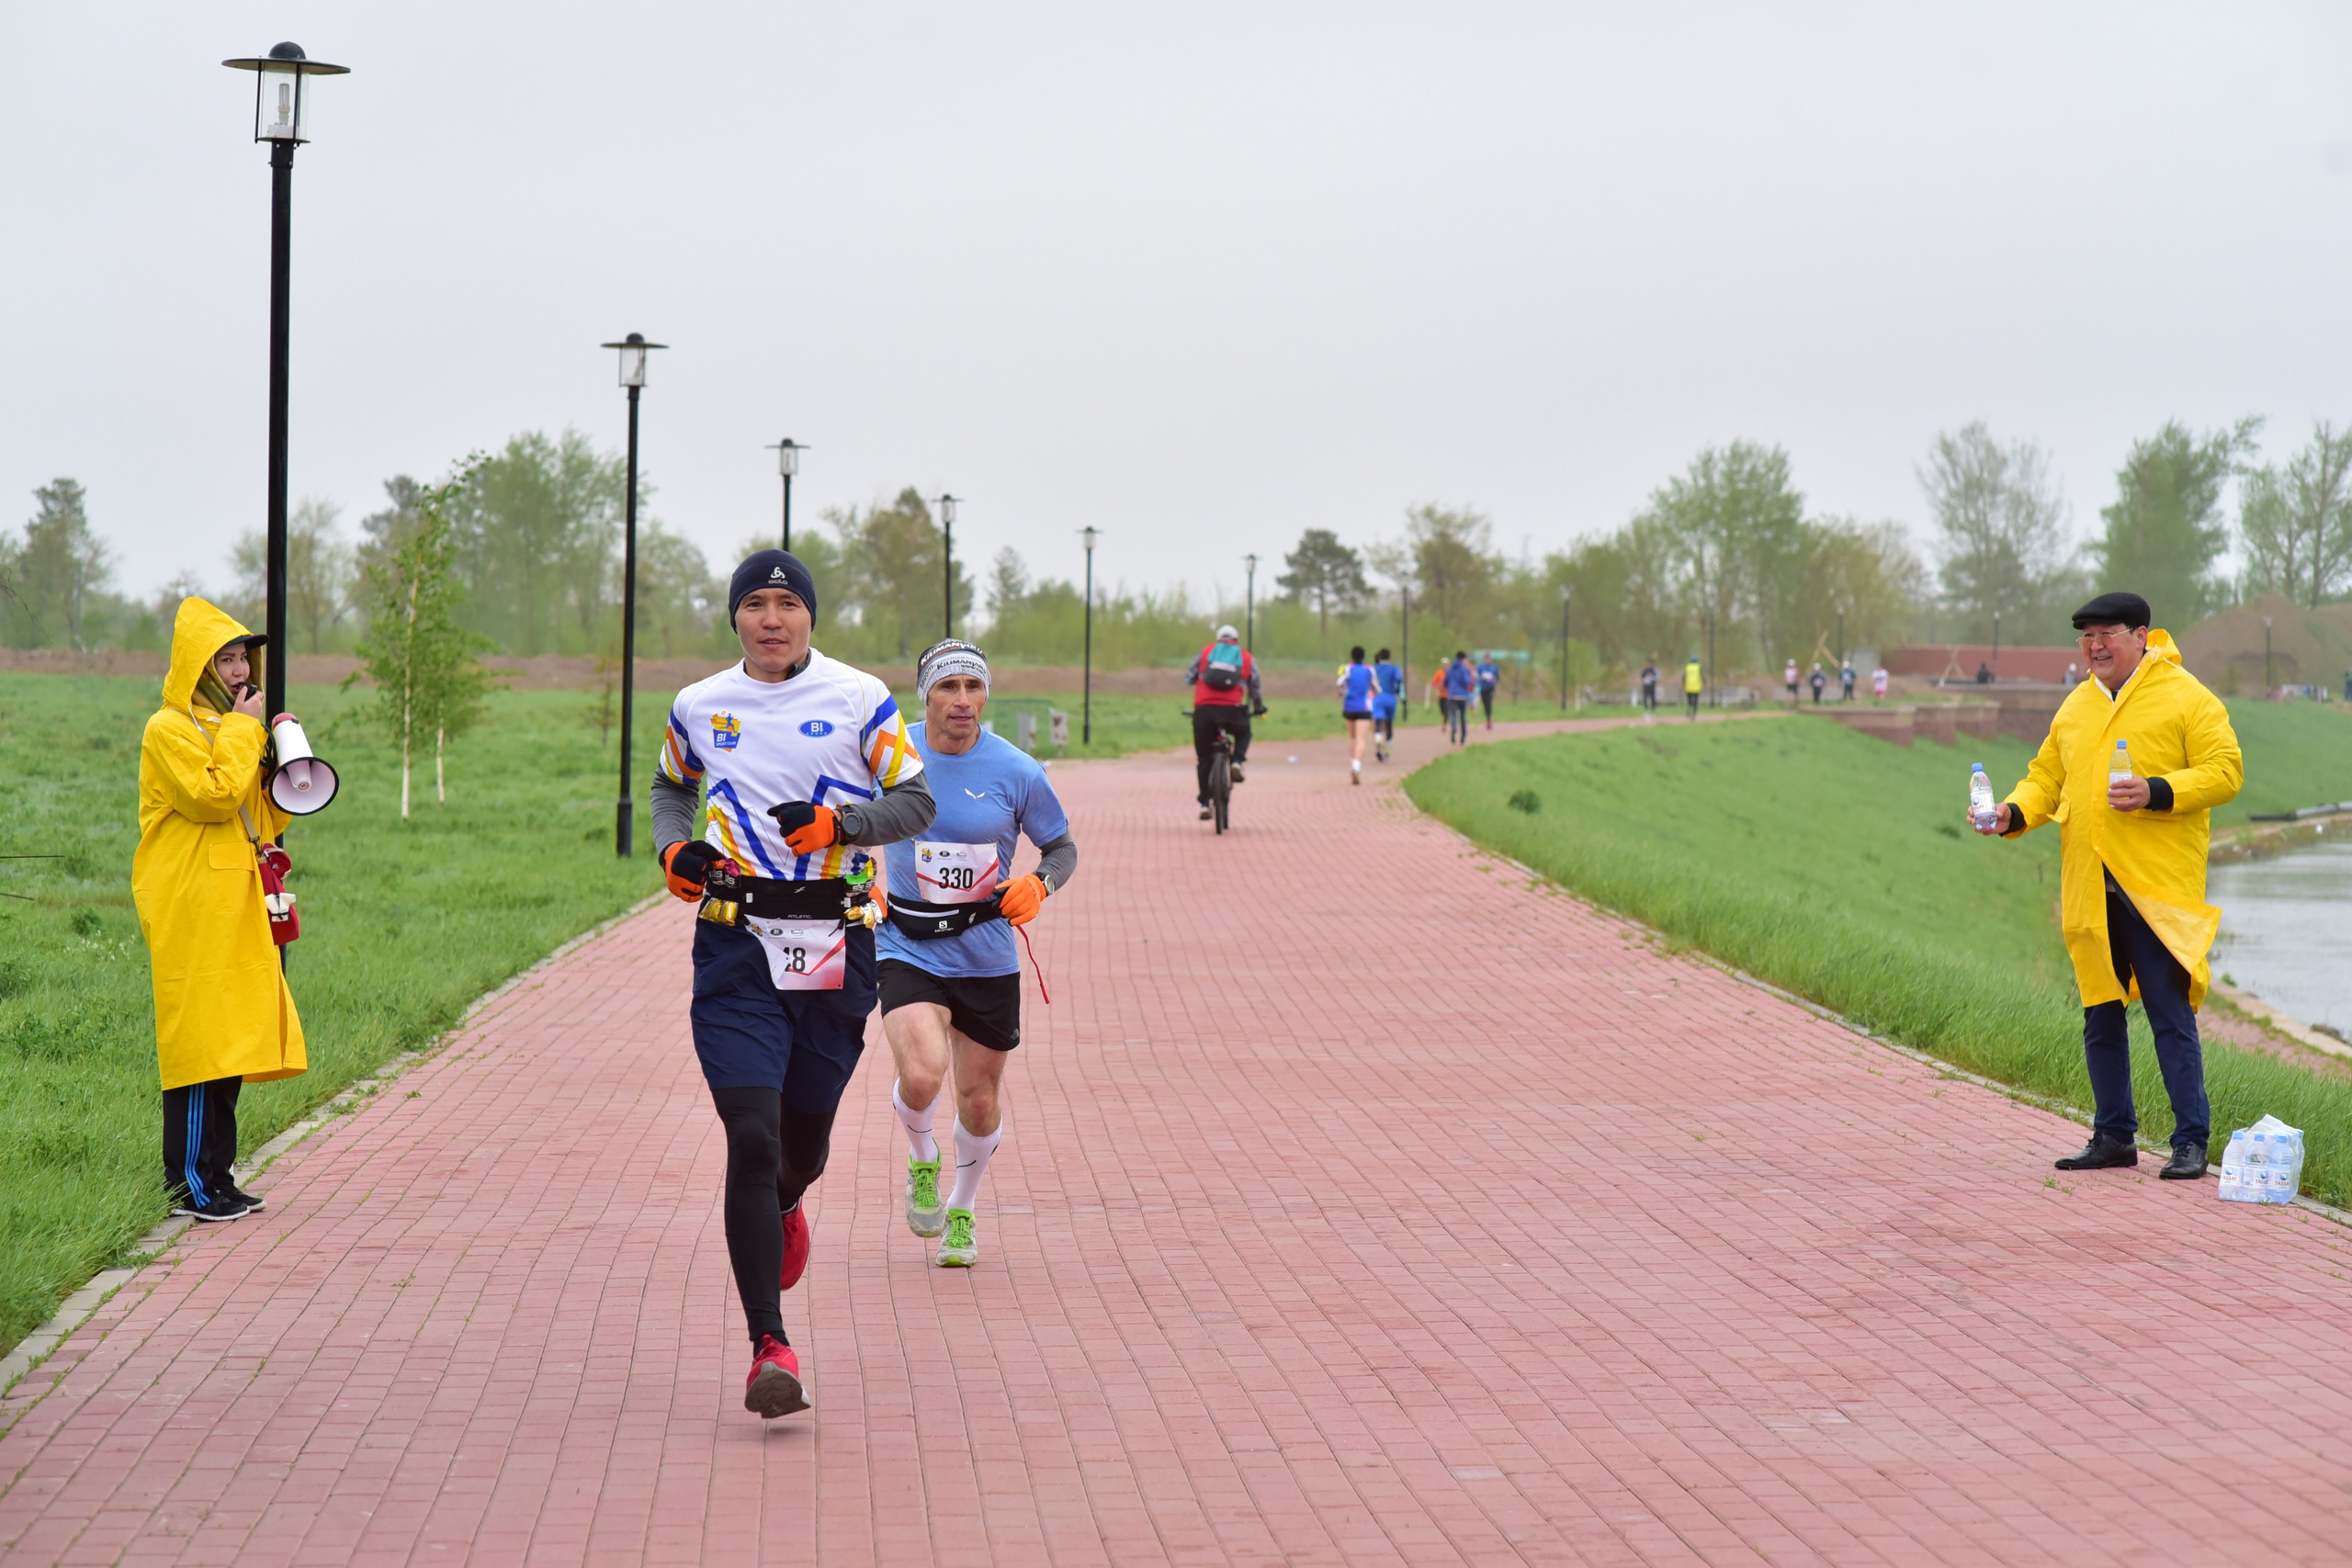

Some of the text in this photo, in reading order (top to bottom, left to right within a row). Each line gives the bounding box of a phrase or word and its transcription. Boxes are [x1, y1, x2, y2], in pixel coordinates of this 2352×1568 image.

[811, 722, 823, 733] BI
[716, 733, 726, 742] BI
[939, 867, 973, 889] 330
